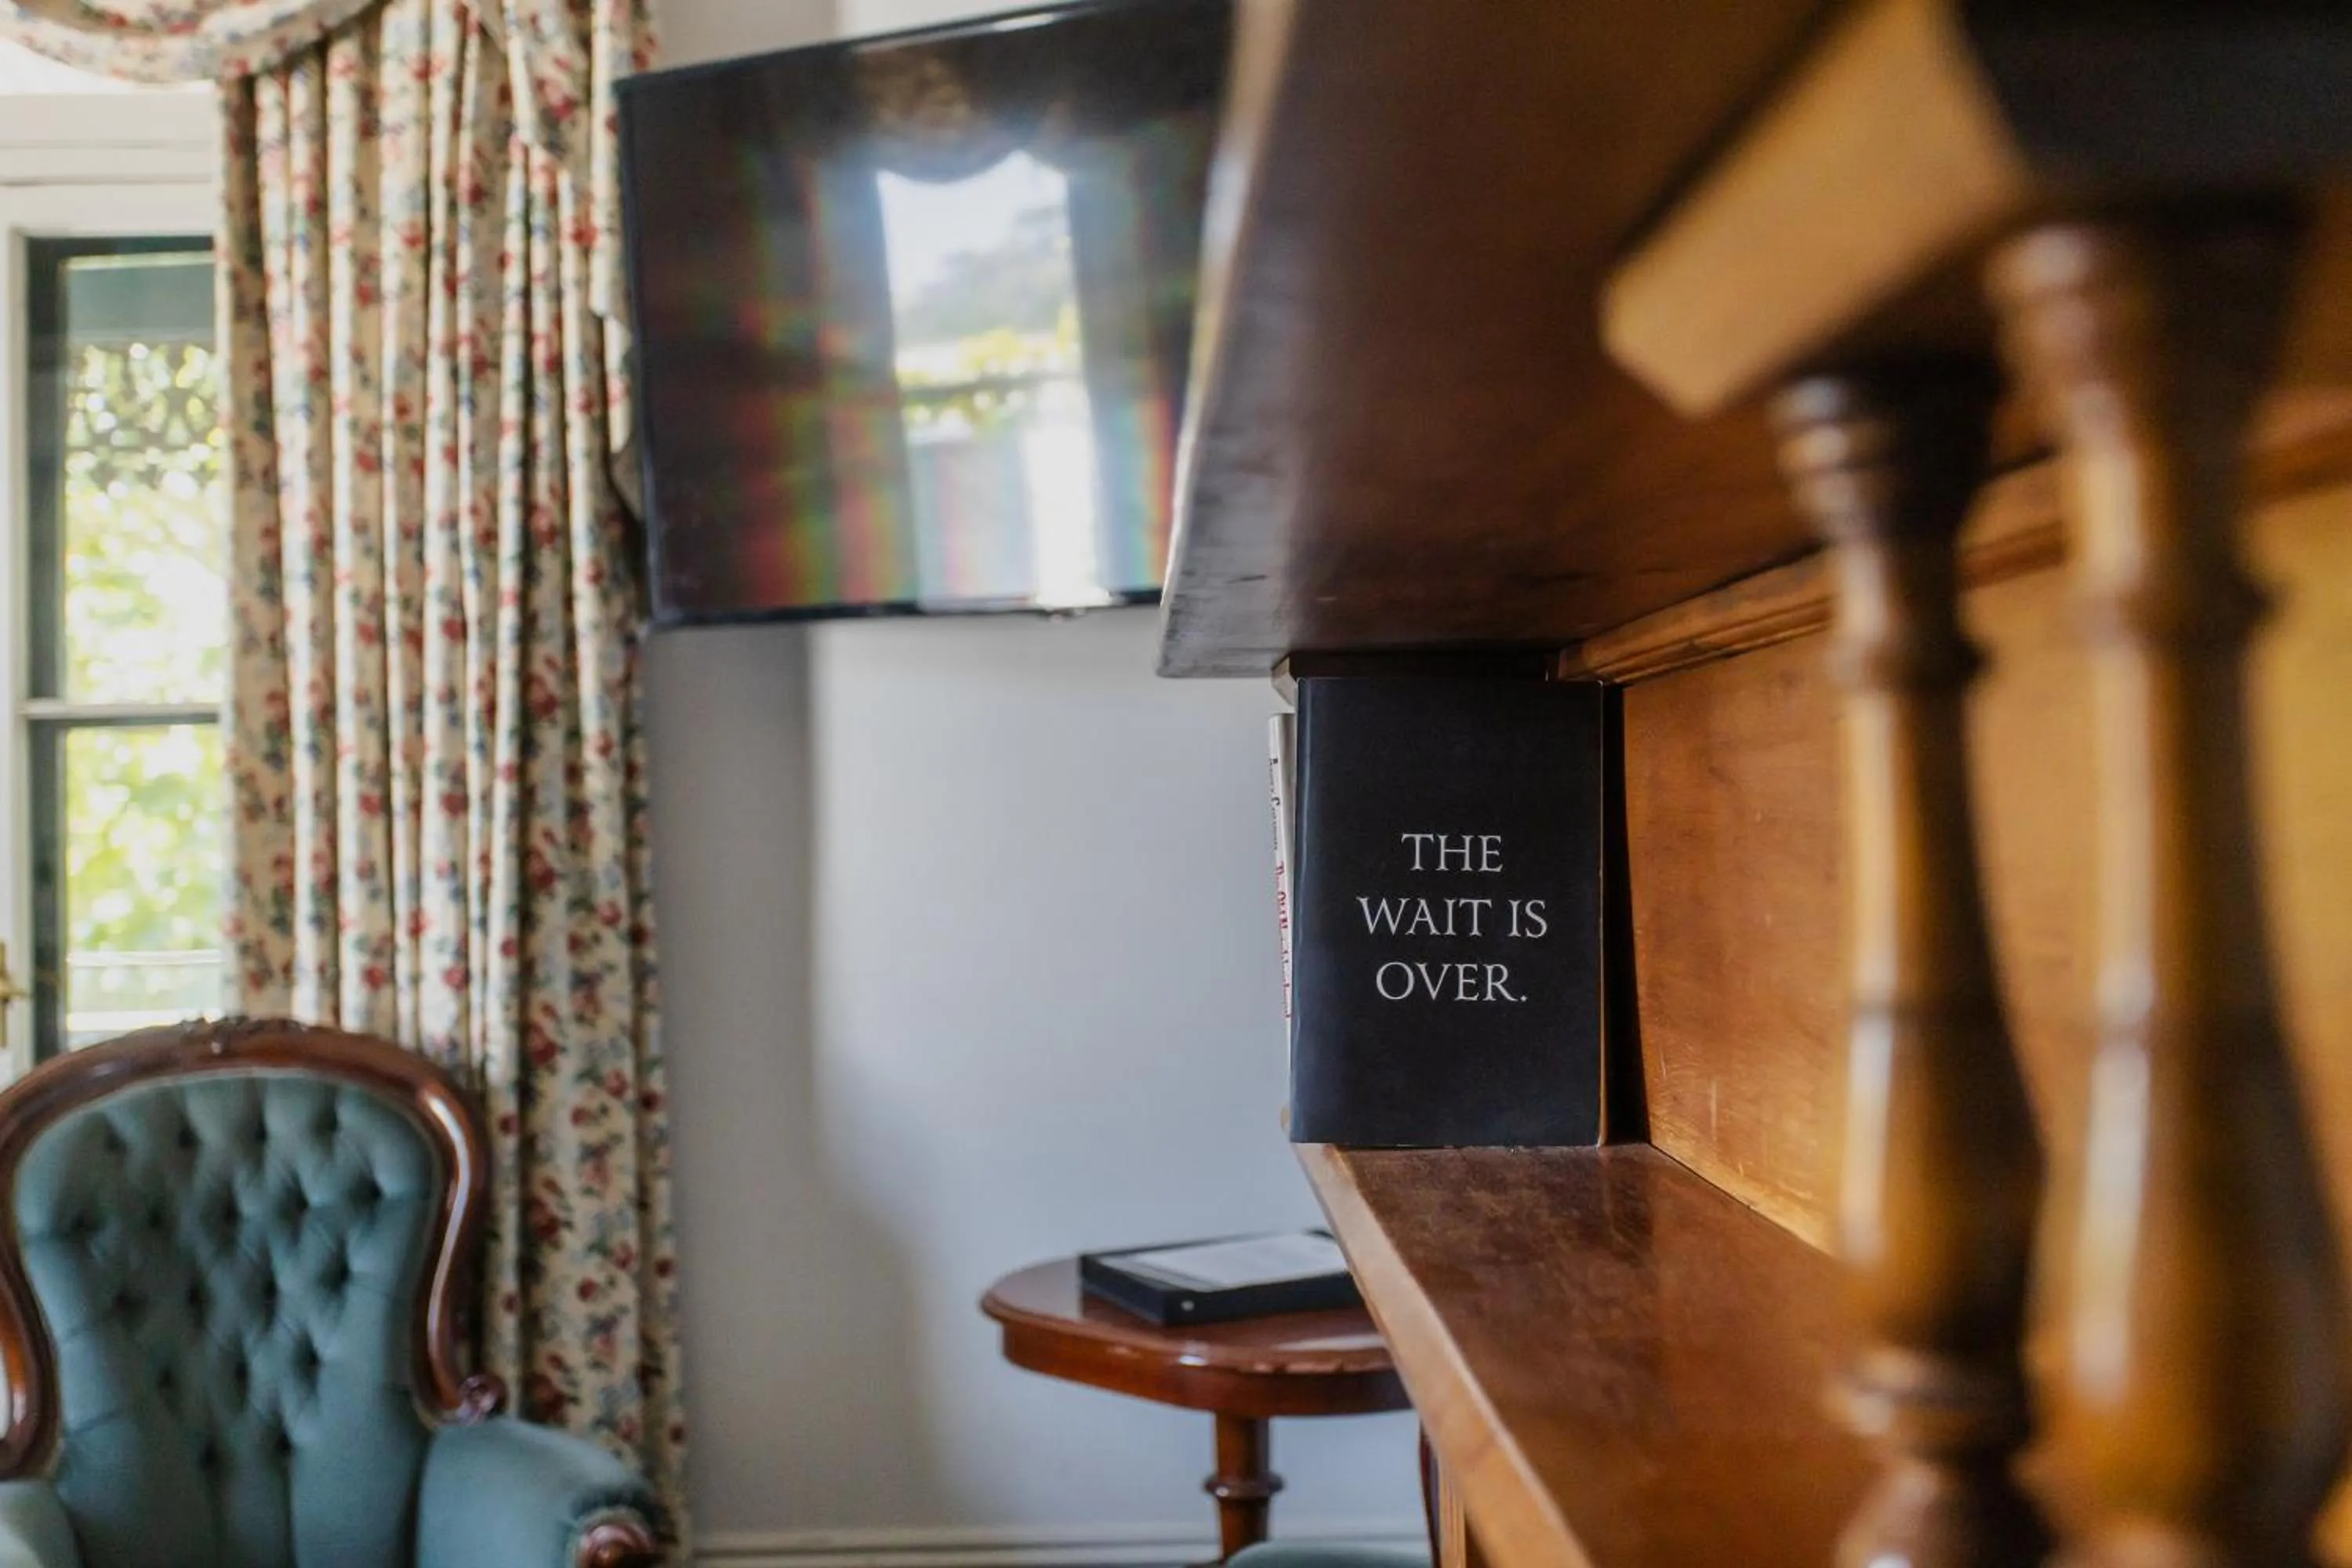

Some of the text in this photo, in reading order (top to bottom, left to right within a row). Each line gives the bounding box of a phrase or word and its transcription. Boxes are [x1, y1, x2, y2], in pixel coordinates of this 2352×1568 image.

[1401, 833, 1503, 873] THE
[1357, 897, 1548, 938] WAIT IS
[1375, 961, 1528, 1002] OVER.
